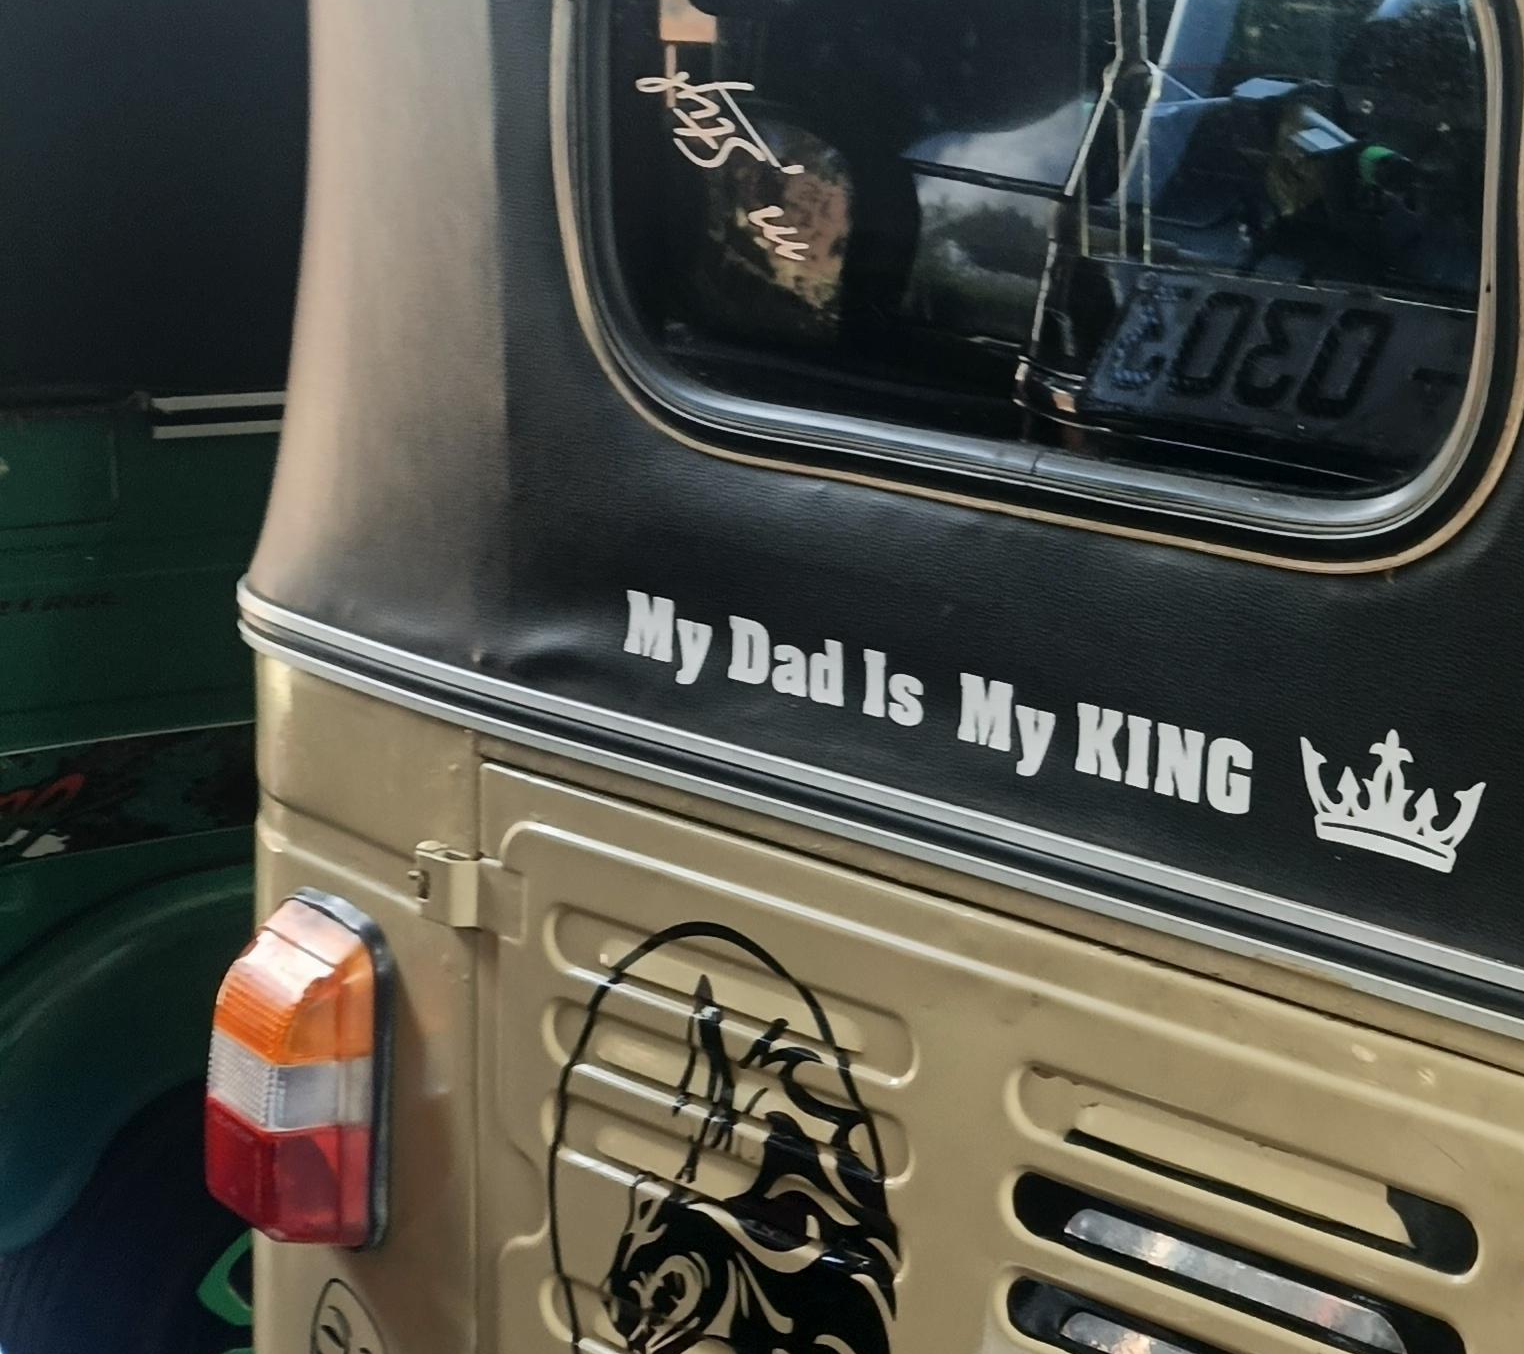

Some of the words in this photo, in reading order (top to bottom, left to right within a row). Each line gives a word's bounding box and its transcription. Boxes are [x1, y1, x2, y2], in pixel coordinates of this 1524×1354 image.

[623, 589, 713, 685] My
[727, 615, 845, 707] Dad
[862, 648, 924, 727] Is
[957, 672, 1056, 777] My
[1074, 702, 1253, 815] KING
